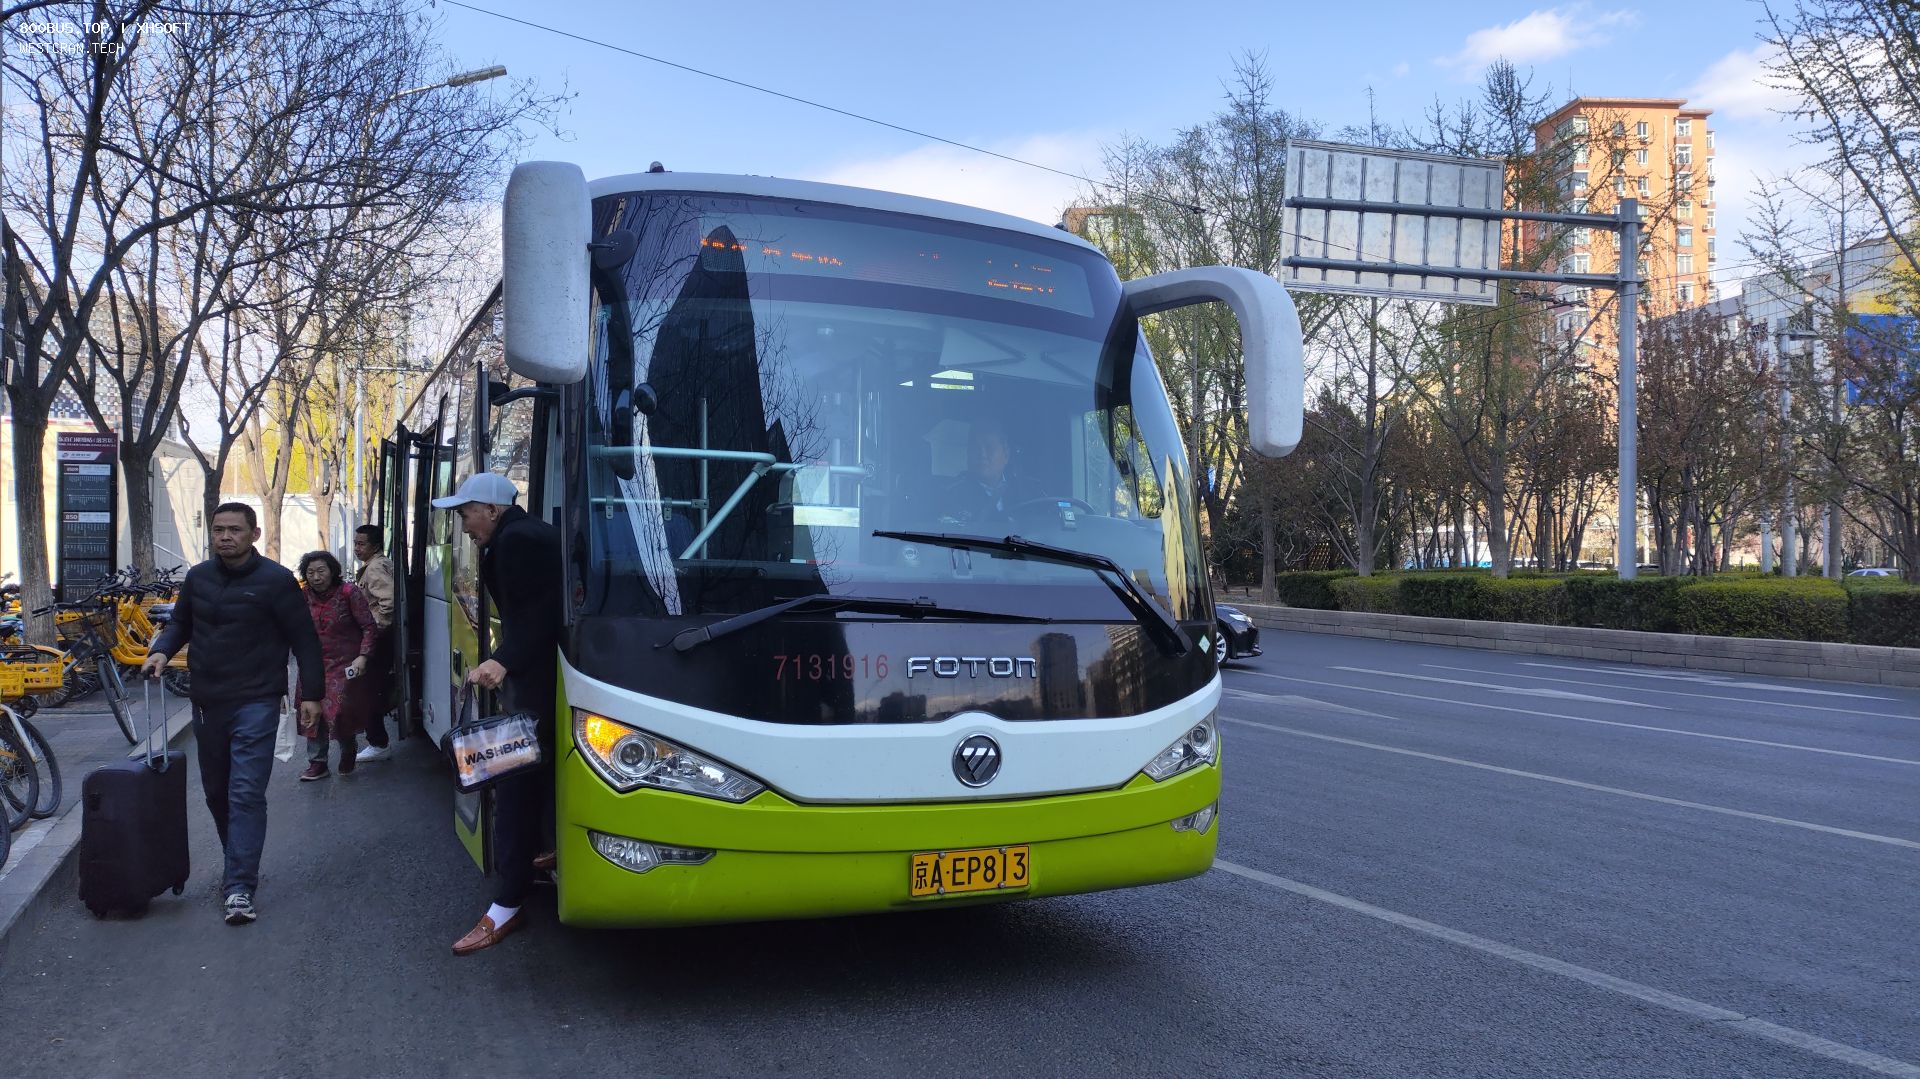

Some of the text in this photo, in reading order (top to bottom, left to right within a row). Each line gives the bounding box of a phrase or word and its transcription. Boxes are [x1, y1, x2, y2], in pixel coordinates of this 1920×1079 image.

[773, 654, 889, 681] 7131916
[906, 656, 1037, 679] FOTON
[464, 737, 532, 766] WASHBAG
